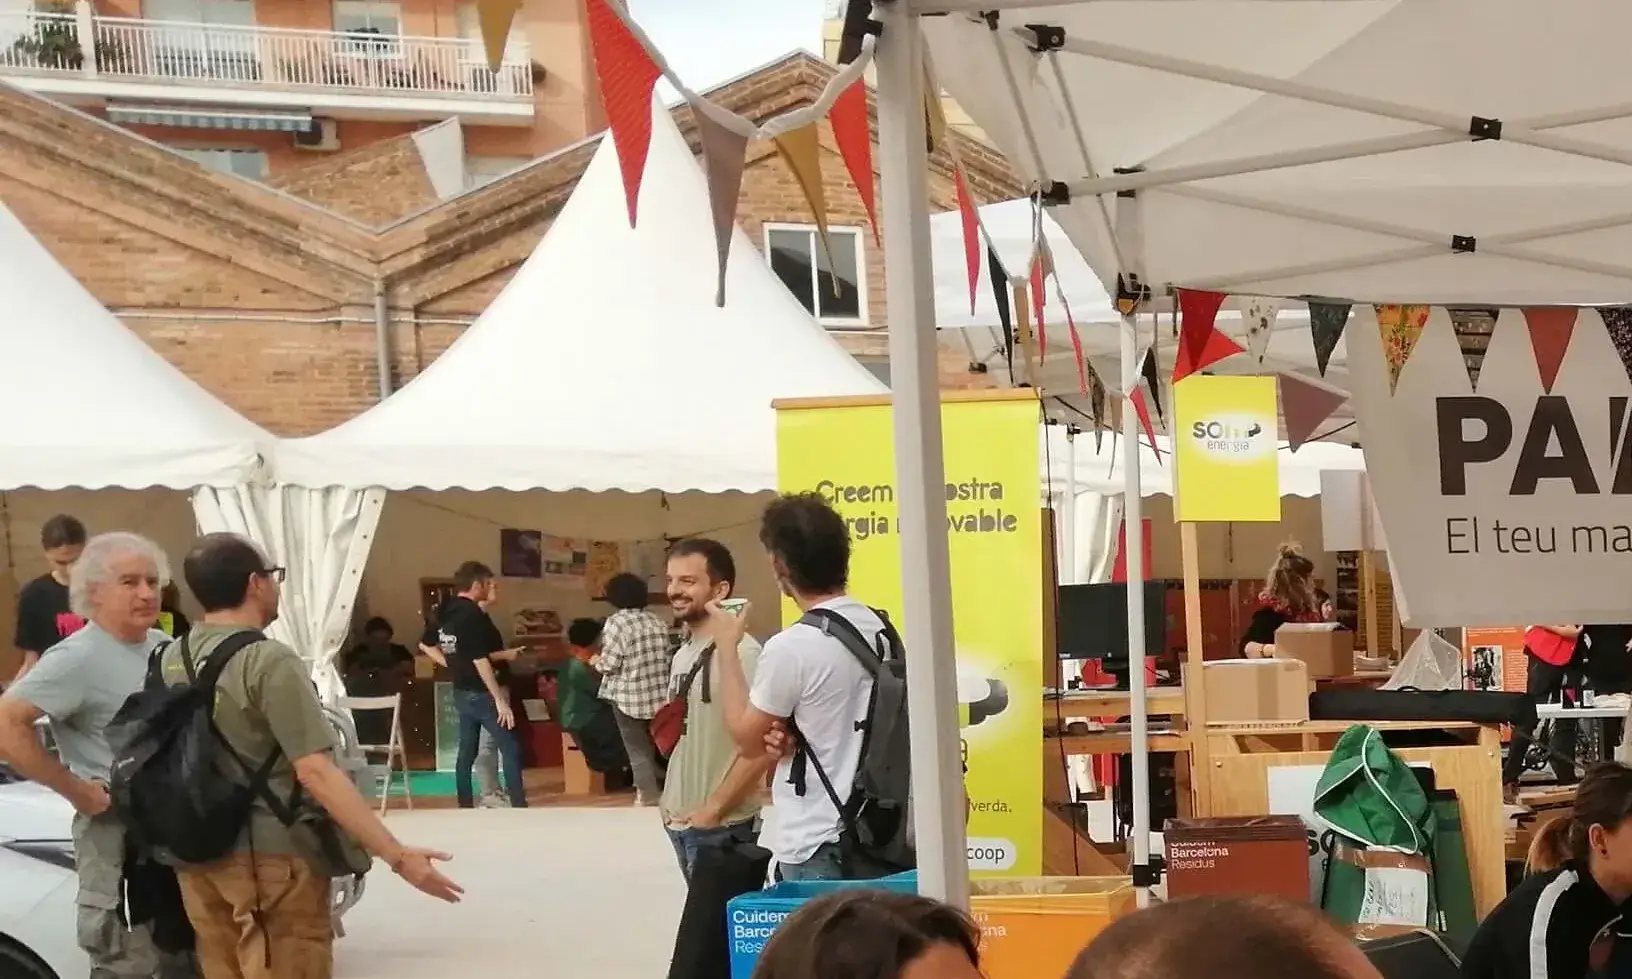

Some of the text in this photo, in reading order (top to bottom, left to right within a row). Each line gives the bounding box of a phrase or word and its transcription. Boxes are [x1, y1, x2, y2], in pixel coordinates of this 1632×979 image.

[815, 477, 1004, 504] Creem ostra
[844, 511, 889, 540] rgia
[1447, 516, 1479, 554] El
[1493, 519, 1556, 553] teu
[1170, 846, 1230, 859] Barcelona
[1171, 858, 1216, 870] Residus
